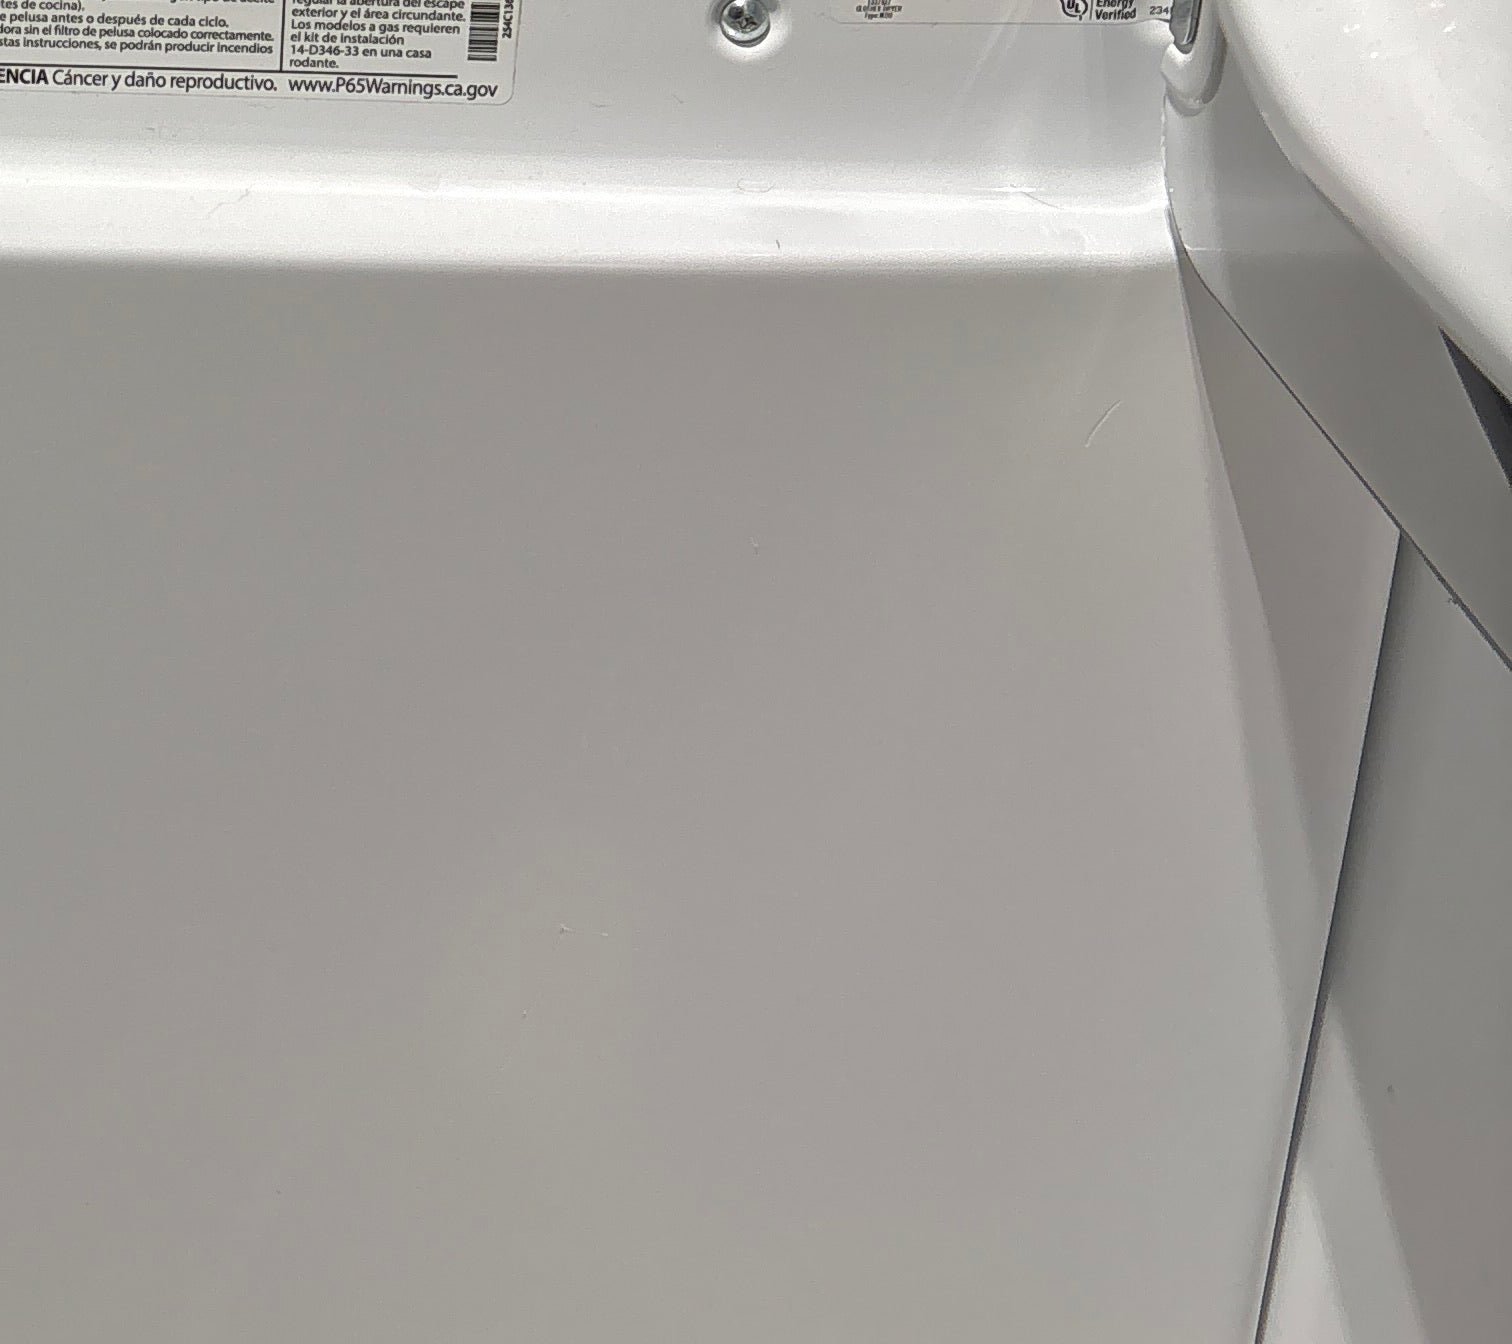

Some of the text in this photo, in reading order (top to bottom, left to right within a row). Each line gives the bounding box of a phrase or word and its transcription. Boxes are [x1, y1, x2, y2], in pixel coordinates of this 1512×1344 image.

[1096, 8, 1136, 20] Verified
[290, 44, 432, 58] 14-D346-33 en una casa
[52, 69, 108, 86] Cáncer
[111, 76, 121, 91] y
[124, 70, 167, 88] daño
[170, 73, 278, 92] reproductivo.
[288, 77, 498, 100] www.P65Warnings.ca.gov
